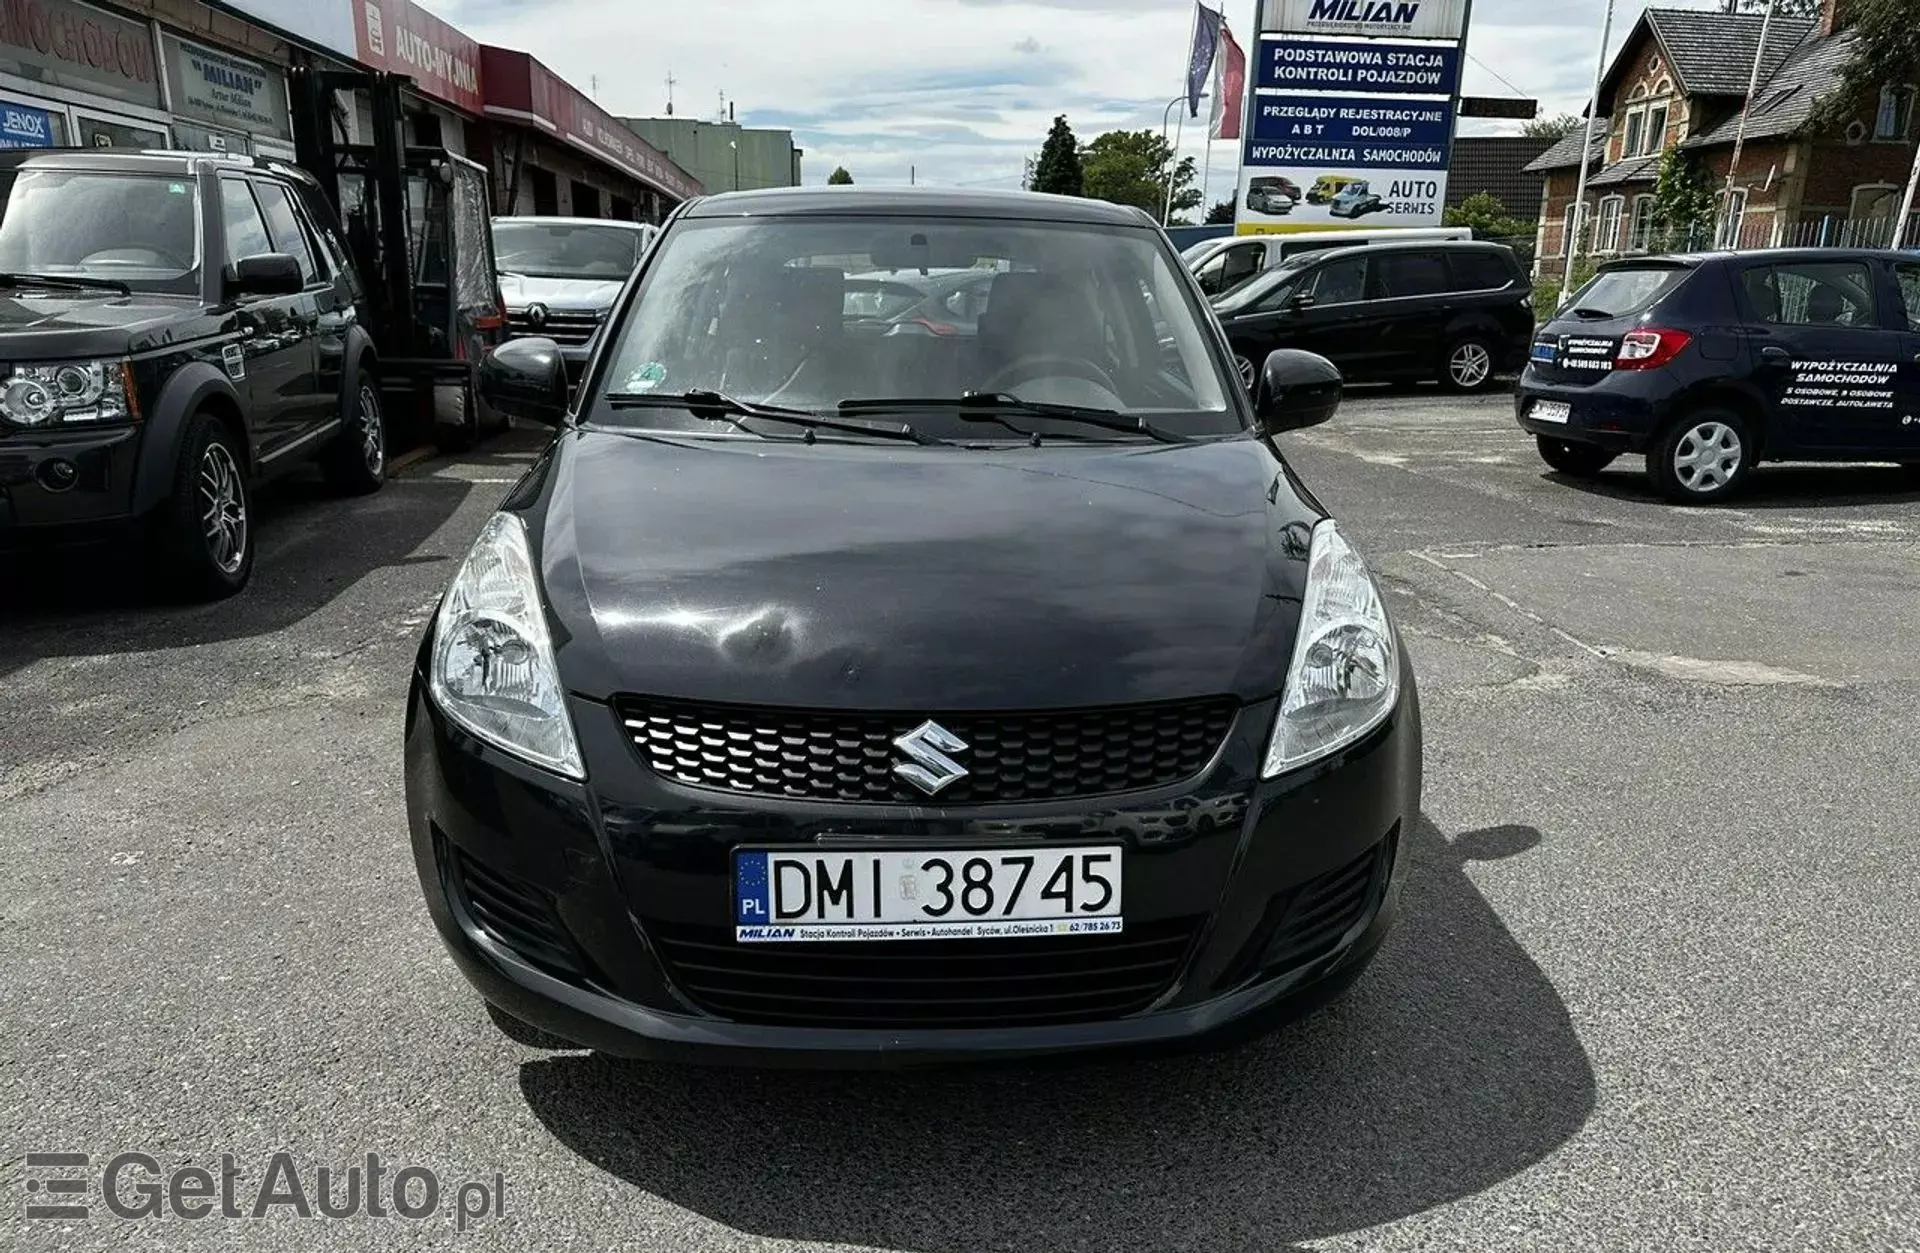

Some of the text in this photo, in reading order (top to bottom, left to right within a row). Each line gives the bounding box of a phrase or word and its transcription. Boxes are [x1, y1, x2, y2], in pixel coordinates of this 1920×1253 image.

[1308, 0, 1419, 23] MILIAN
[1274, 48, 1443, 68] PODSTAWOWA STACJA
[1274, 66, 1441, 85] KONTROLI POJAZDÓW
[3, 110, 44, 133] JENOX
[1263, 106, 1443, 122] PRZEGLĄDY REJESTRACYJNE
[1291, 125, 1411, 137] A B T DOL/008/P
[1253, 143, 1441, 163] WYPOŻYCZALNIA SAMOCHODÓW
[1389, 181, 1437, 199] AUTO
[1387, 202, 1435, 215] SERWIS
[1791, 359, 1898, 373] WYPOŻYCZALNIA
[1795, 373, 1890, 384] SAMOCHODÓW
[1849, 390, 1894, 398] OSOBOWE
[1836, 400, 1893, 408] AUTOLAWETA
[774, 853, 1114, 920] DMI 38745
[742, 899, 766, 915] PL
[739, 929, 796, 938] MILIAN
[800, 929, 825, 940] Stacja
[826, 928, 856, 938] Kontroli
[858, 928, 894, 940] Pojazdów
[901, 928, 926, 937] Serwis
[931, 927, 973, 937] Autohandel
[1099, 922, 1110, 931] 26
[1111, 921, 1121, 930] 73
